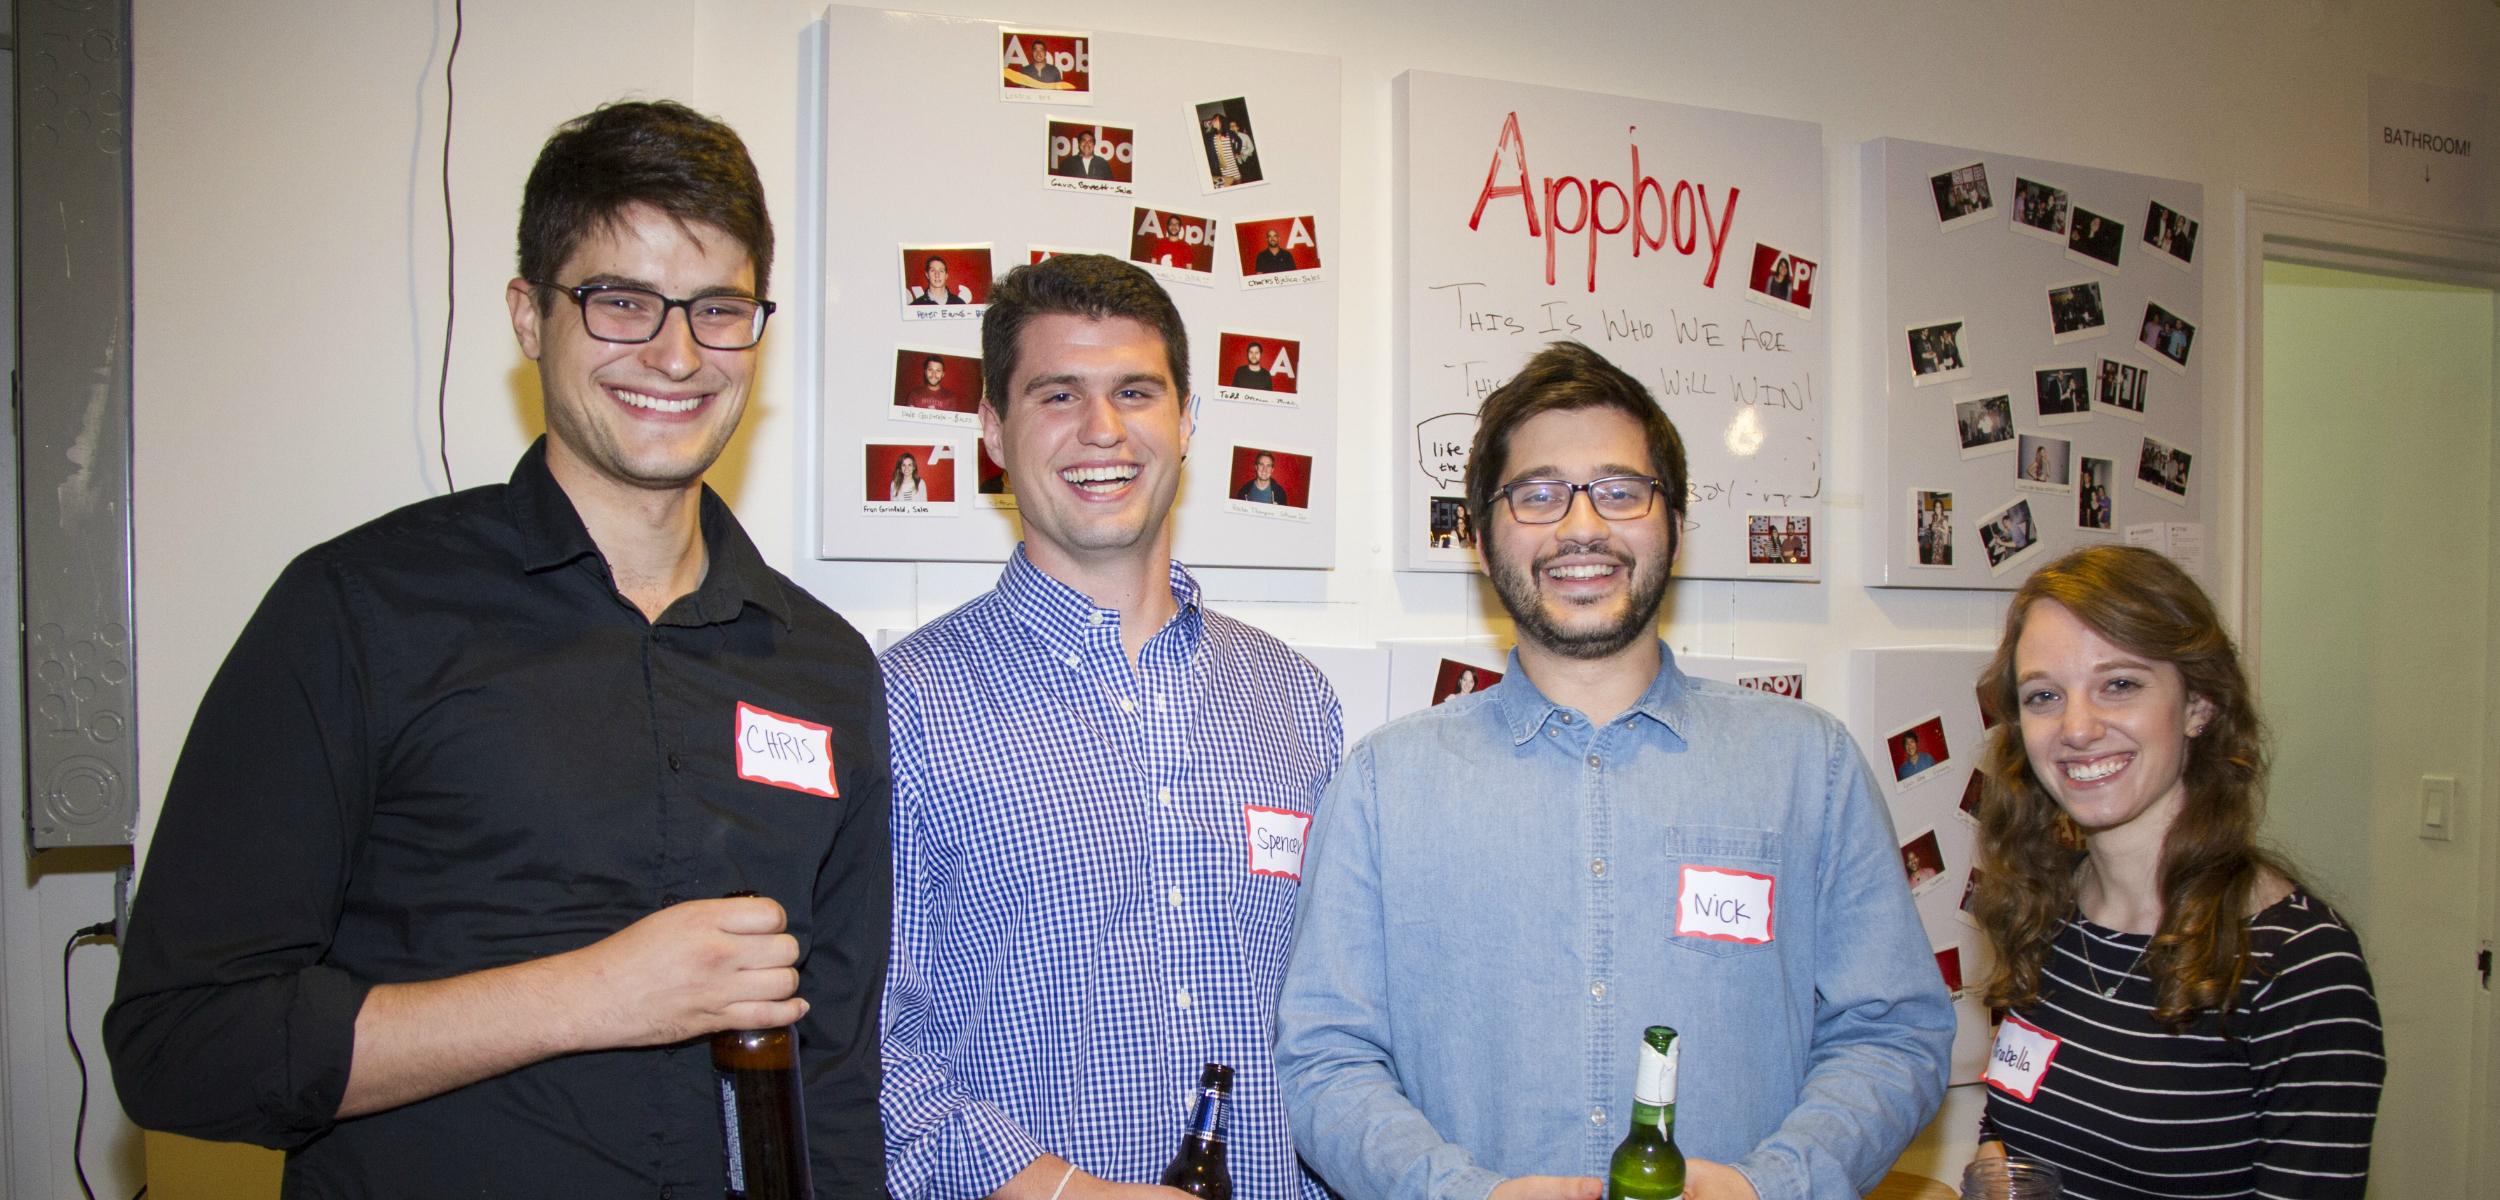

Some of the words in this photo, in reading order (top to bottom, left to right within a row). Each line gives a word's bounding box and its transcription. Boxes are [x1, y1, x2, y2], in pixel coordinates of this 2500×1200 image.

[1004, 34, 1088, 80] Apb
[2383, 126, 2471, 157] BATHROOM!
[1468, 111, 1740, 292] Appboy
[1602, 308, 1654, 342] WHO
[1671, 308, 1725, 347] WE
[1741, 319, 1791, 352] ARE
[1433, 441, 1464, 457] life
[1440, 463, 1459, 472] the
[746, 724, 815, 763] CHRIS
[1257, 827, 1303, 859] Spencer
